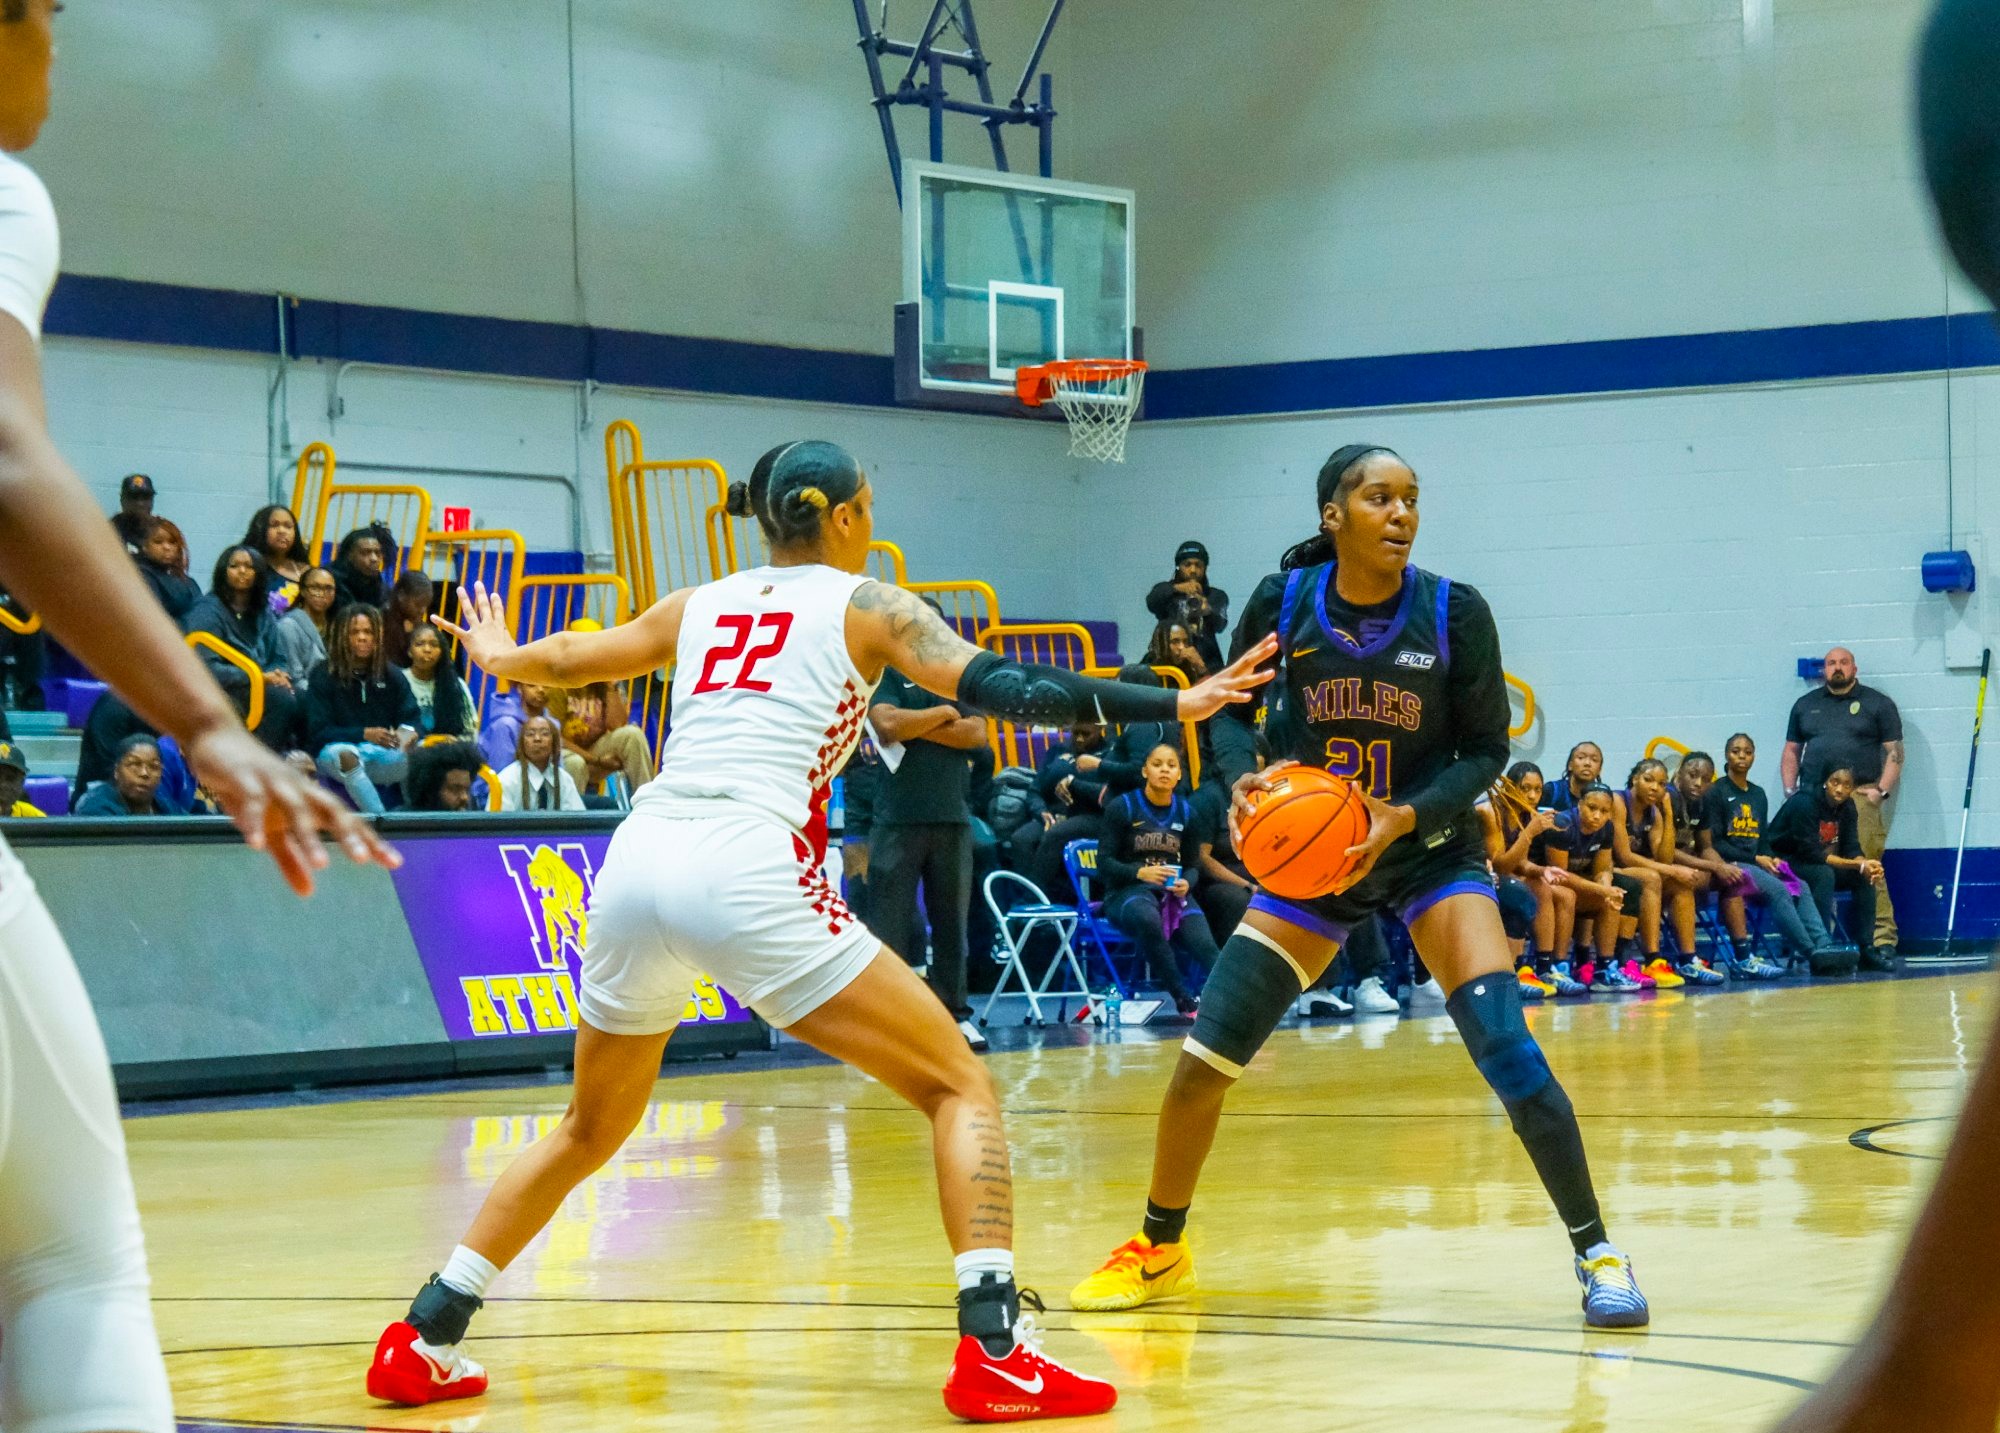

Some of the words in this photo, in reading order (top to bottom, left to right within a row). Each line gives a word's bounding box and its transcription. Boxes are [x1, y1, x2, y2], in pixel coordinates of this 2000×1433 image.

[691, 611, 794, 695] 22
[1397, 652, 1434, 667] SIAC
[1303, 677, 1422, 731] MILES
[1325, 736, 1392, 801] 21
